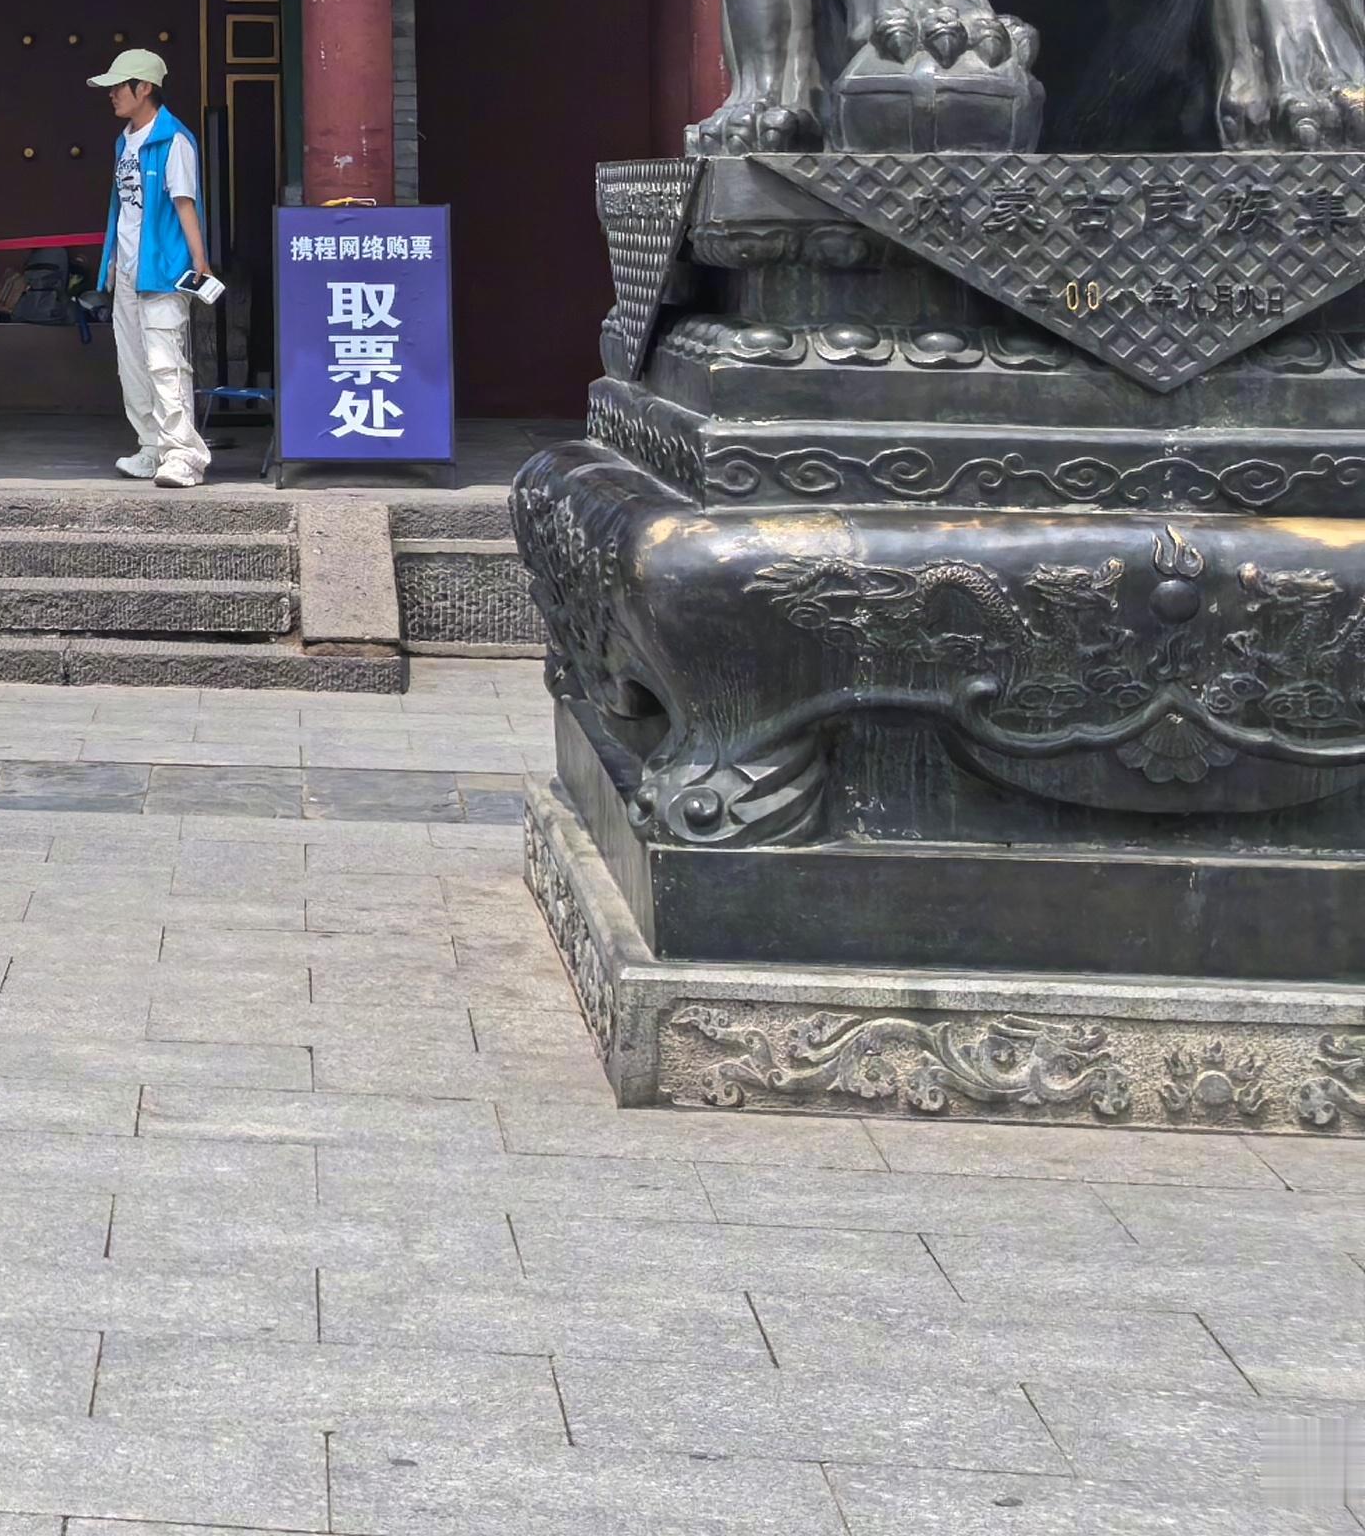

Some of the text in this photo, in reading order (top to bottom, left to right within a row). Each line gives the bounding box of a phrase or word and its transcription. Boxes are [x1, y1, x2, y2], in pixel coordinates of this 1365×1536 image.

[290, 235, 433, 261] 携程网络购票
[326, 282, 406, 439] 取票处
